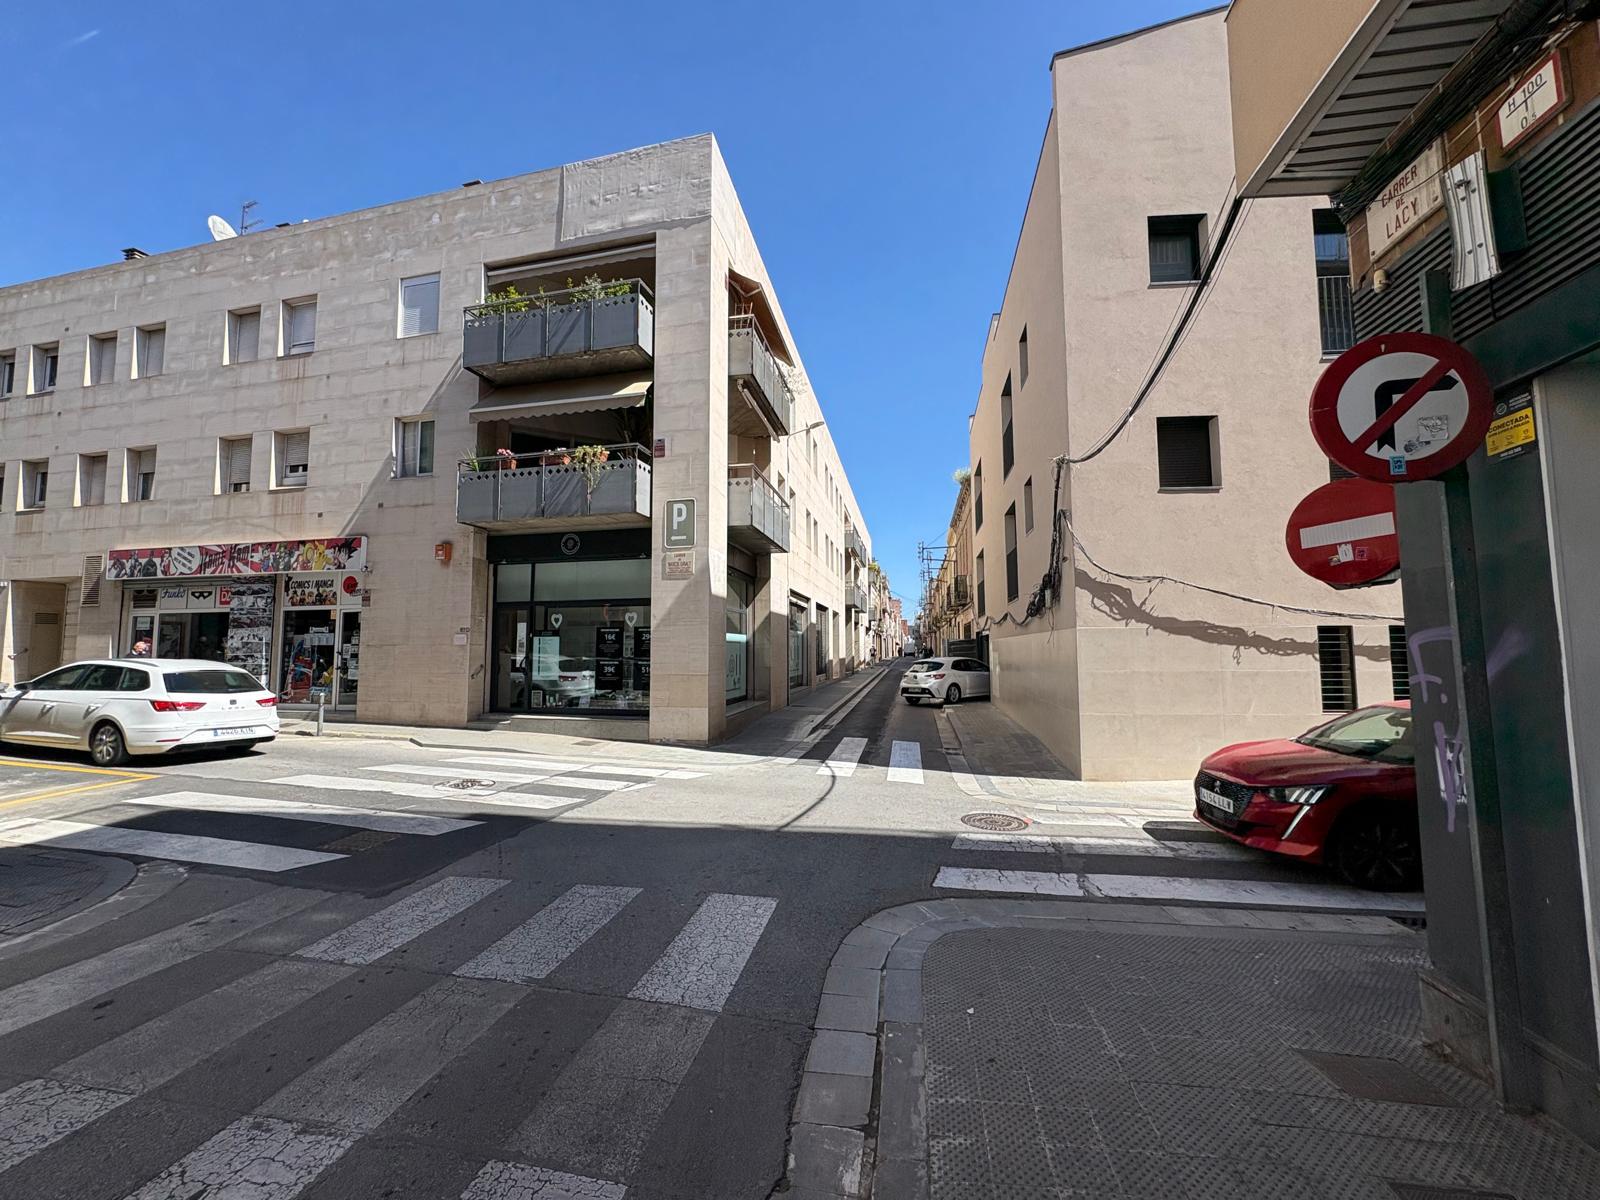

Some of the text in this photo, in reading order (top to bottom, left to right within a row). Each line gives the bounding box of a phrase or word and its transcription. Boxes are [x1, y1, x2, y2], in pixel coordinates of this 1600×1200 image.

[1507, 73, 1543, 112] H 100
[1381, 164, 1418, 208] CARRER
[1395, 195, 1406, 210] DE
[1386, 197, 1418, 239] LACY
[672, 503, 688, 530] P
